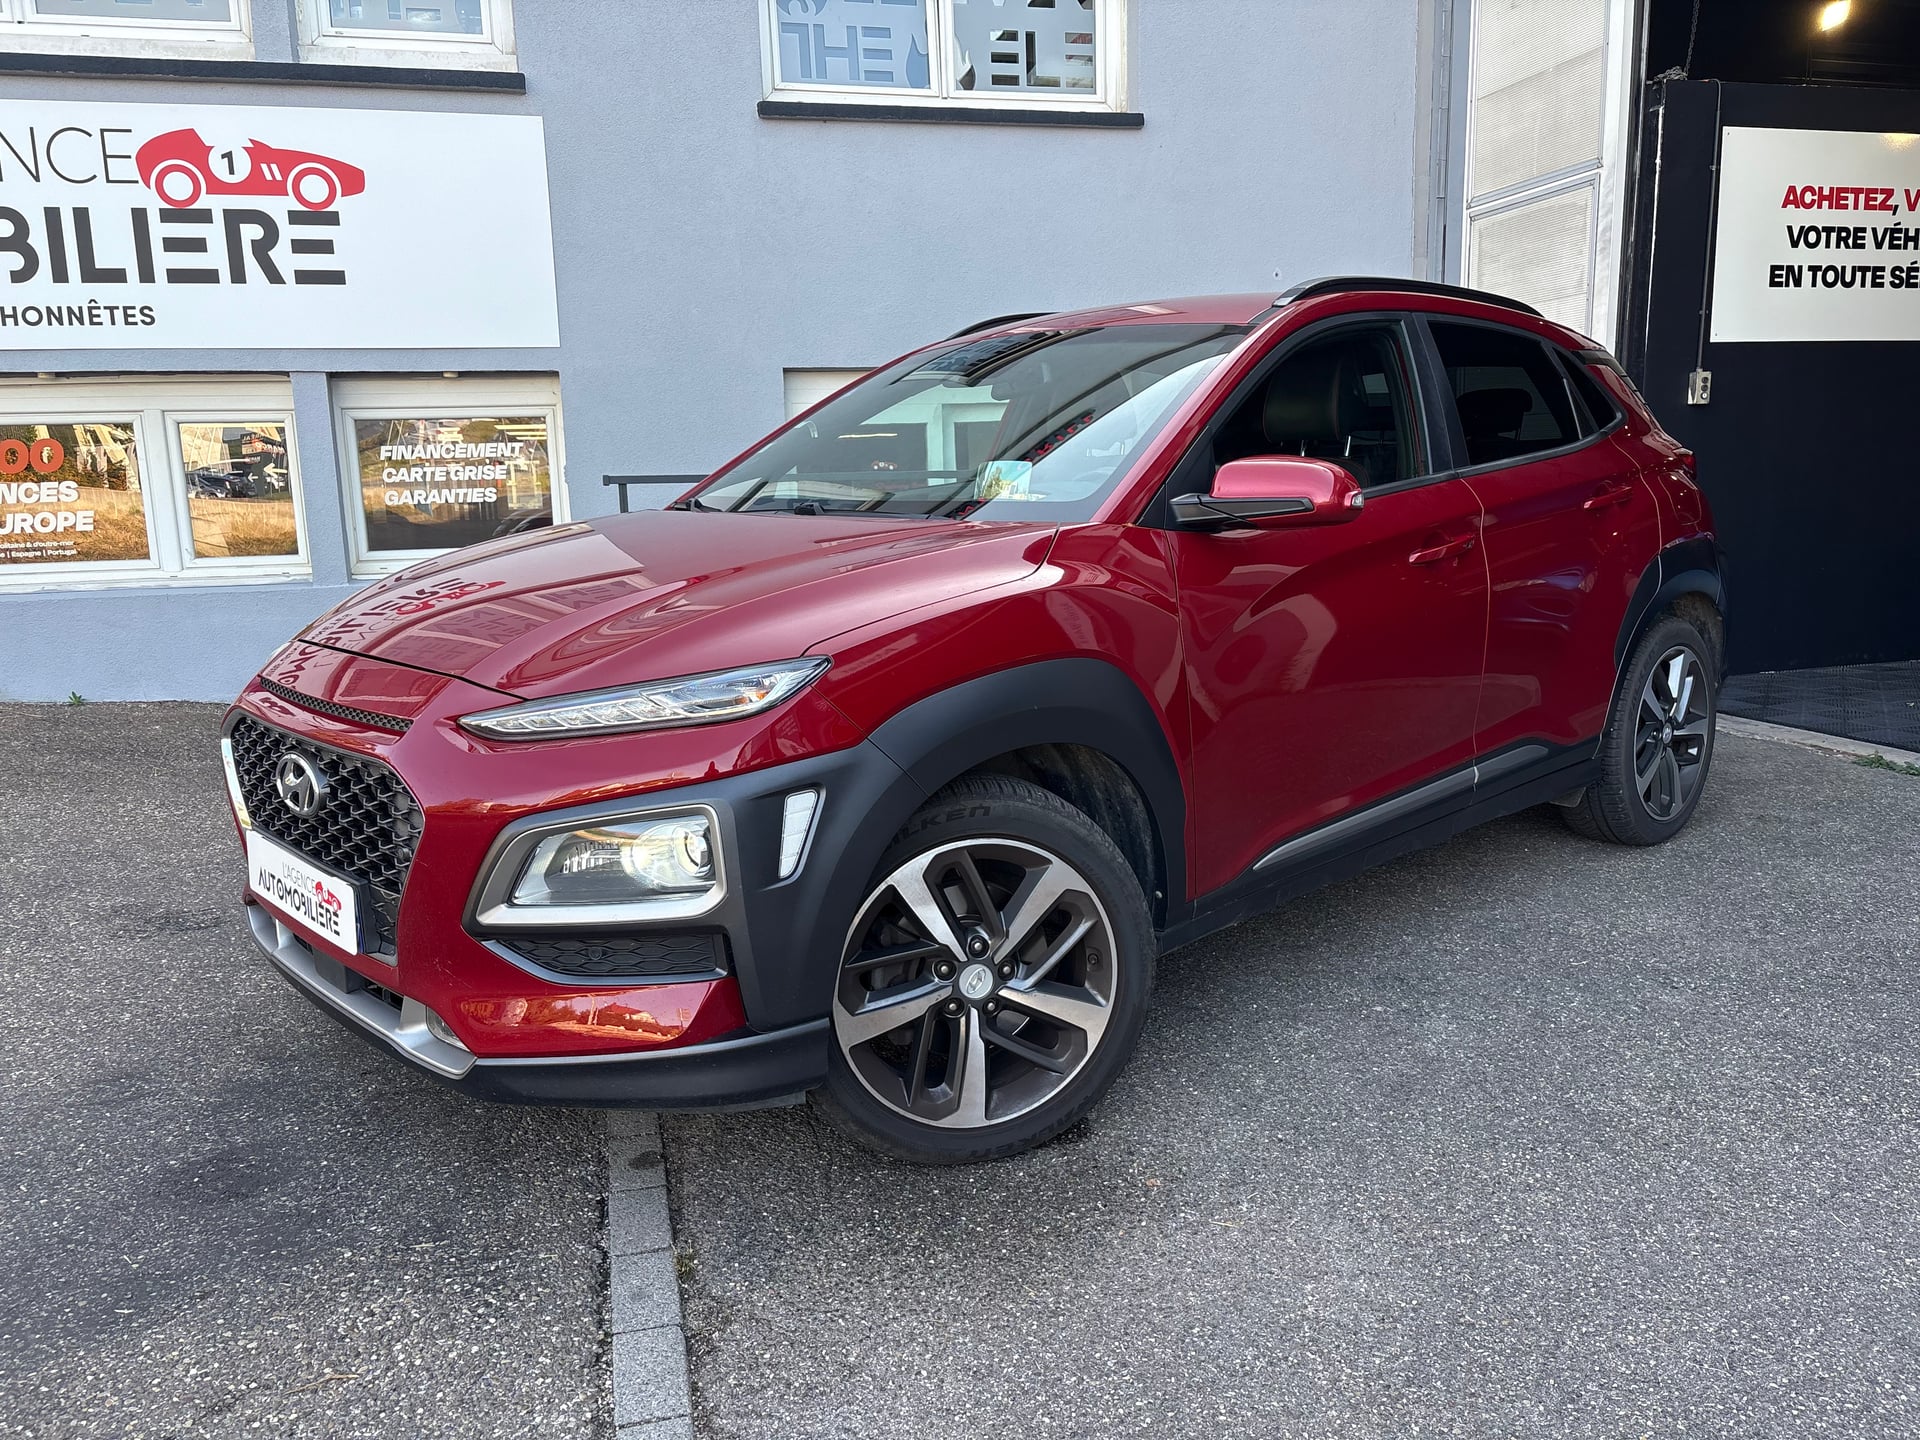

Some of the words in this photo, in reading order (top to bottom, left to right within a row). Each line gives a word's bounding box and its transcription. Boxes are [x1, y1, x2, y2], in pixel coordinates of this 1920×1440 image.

[1781, 185, 1899, 216] ACHETEZ,
[1786, 225, 1867, 250] VOTRE
[1871, 221, 1920, 251] VÉH
[1768, 264, 1803, 288] EN
[1807, 264, 1886, 289] TOUTE
[0, 298, 156, 327] HONNÊTES
[379, 442, 524, 461] FINANCEMENT
[382, 466, 447, 483] CARTE
[450, 464, 508, 481] GRISE
[384, 487, 498, 506] GARANTIES
